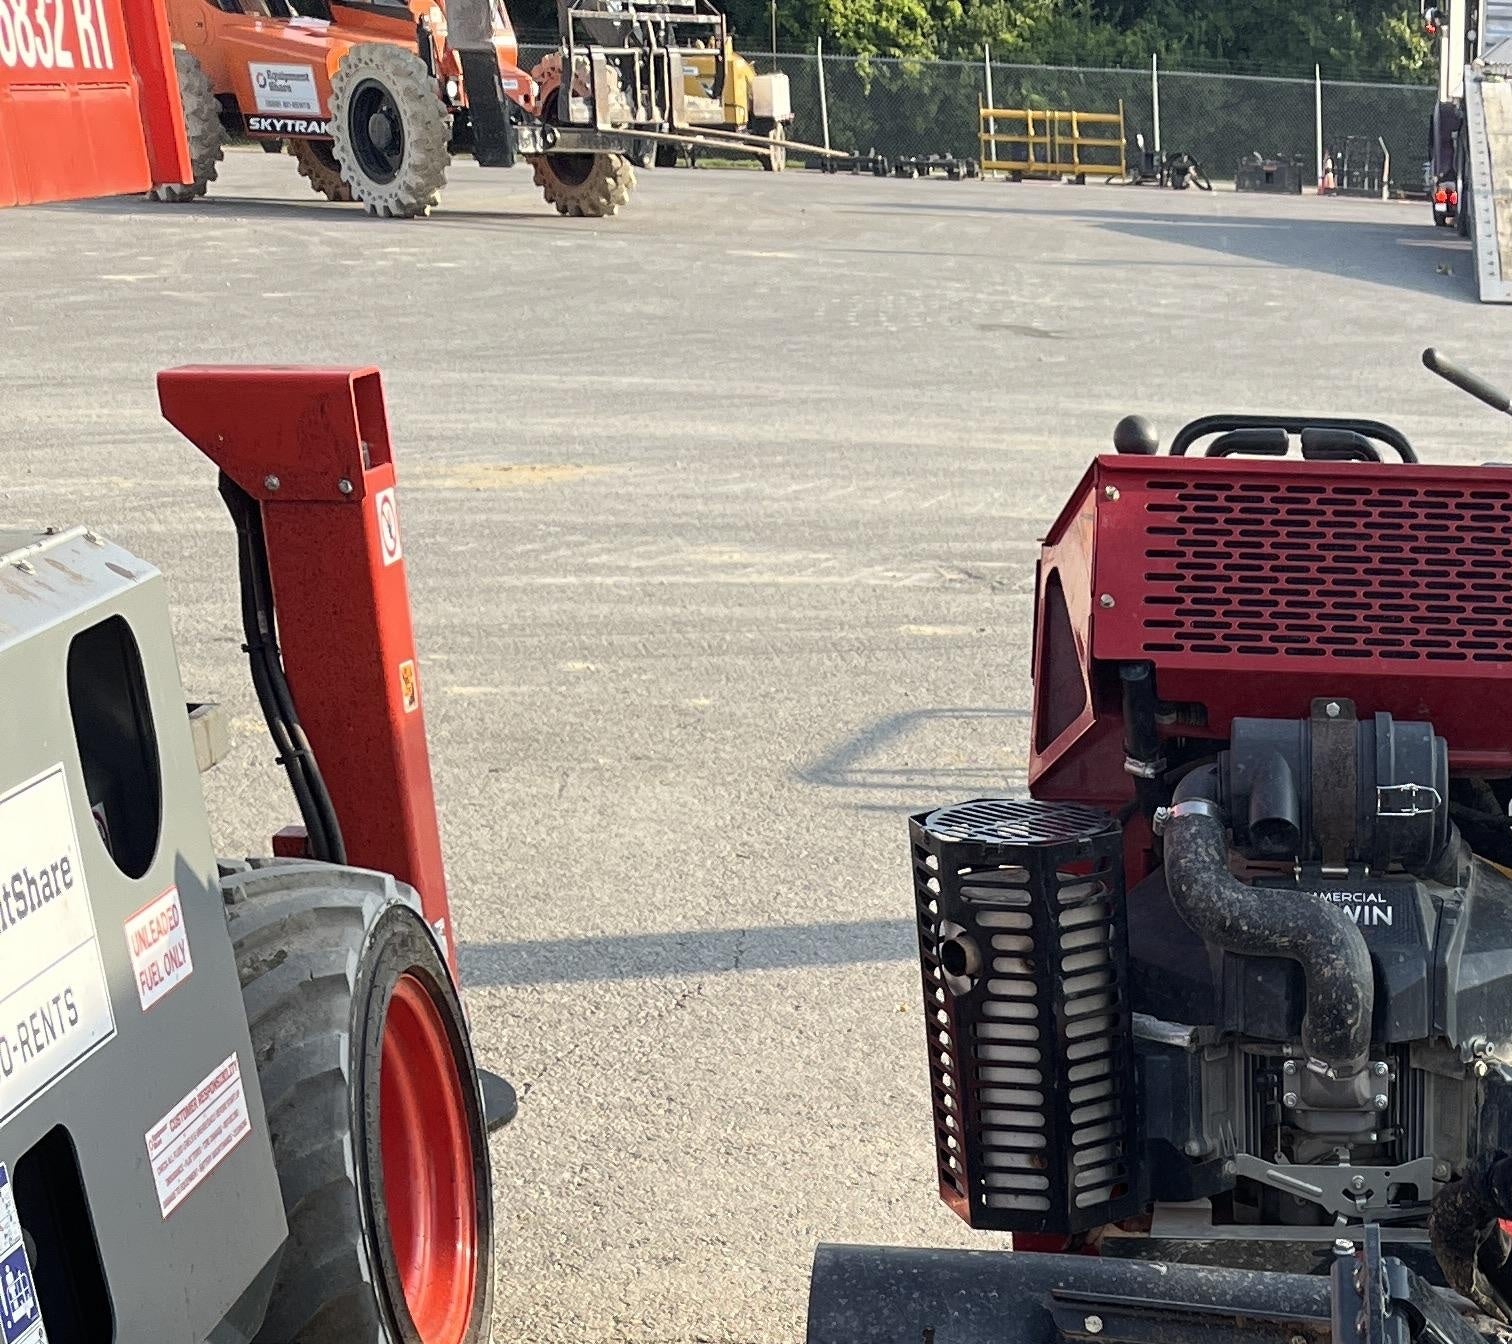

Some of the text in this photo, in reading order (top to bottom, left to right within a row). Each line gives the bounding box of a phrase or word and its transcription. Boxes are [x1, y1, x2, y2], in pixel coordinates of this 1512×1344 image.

[131, 903, 180, 957] UNLEADED
[140, 938, 187, 996] FUEL ONLY
